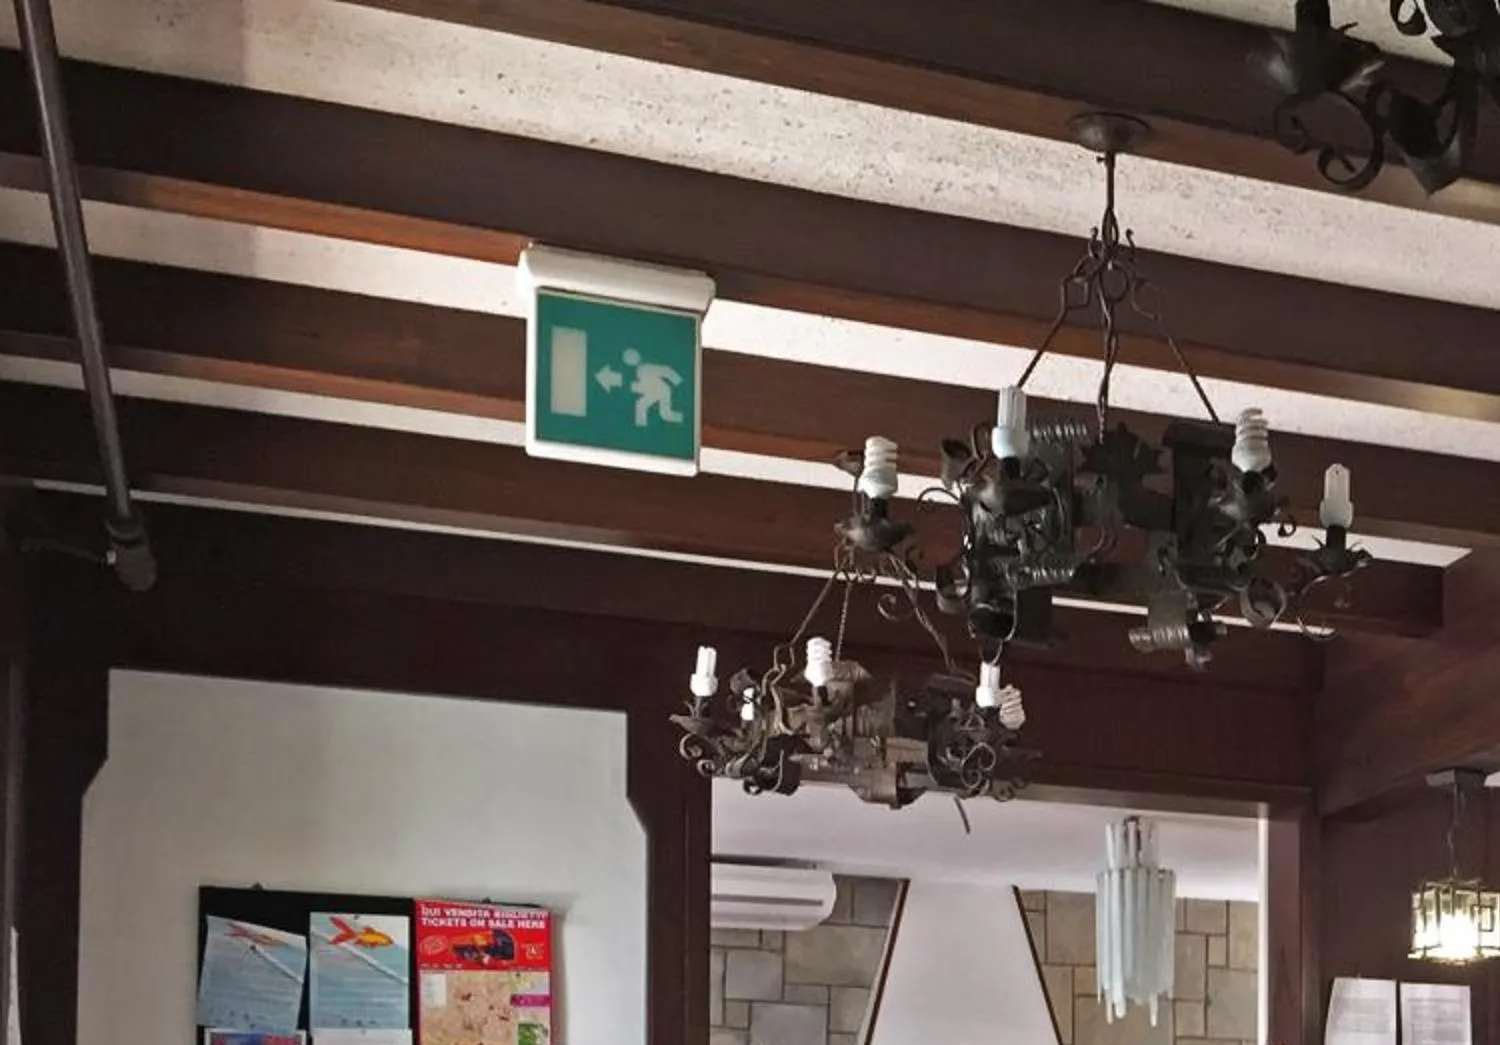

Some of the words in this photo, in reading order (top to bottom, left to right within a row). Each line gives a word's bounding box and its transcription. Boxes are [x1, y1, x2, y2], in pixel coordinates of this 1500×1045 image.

[421, 917, 466, 928] TICKETS
[469, 918, 486, 928] ON
[488, 919, 515, 929] SALE
[517, 920, 546, 929] HERE
